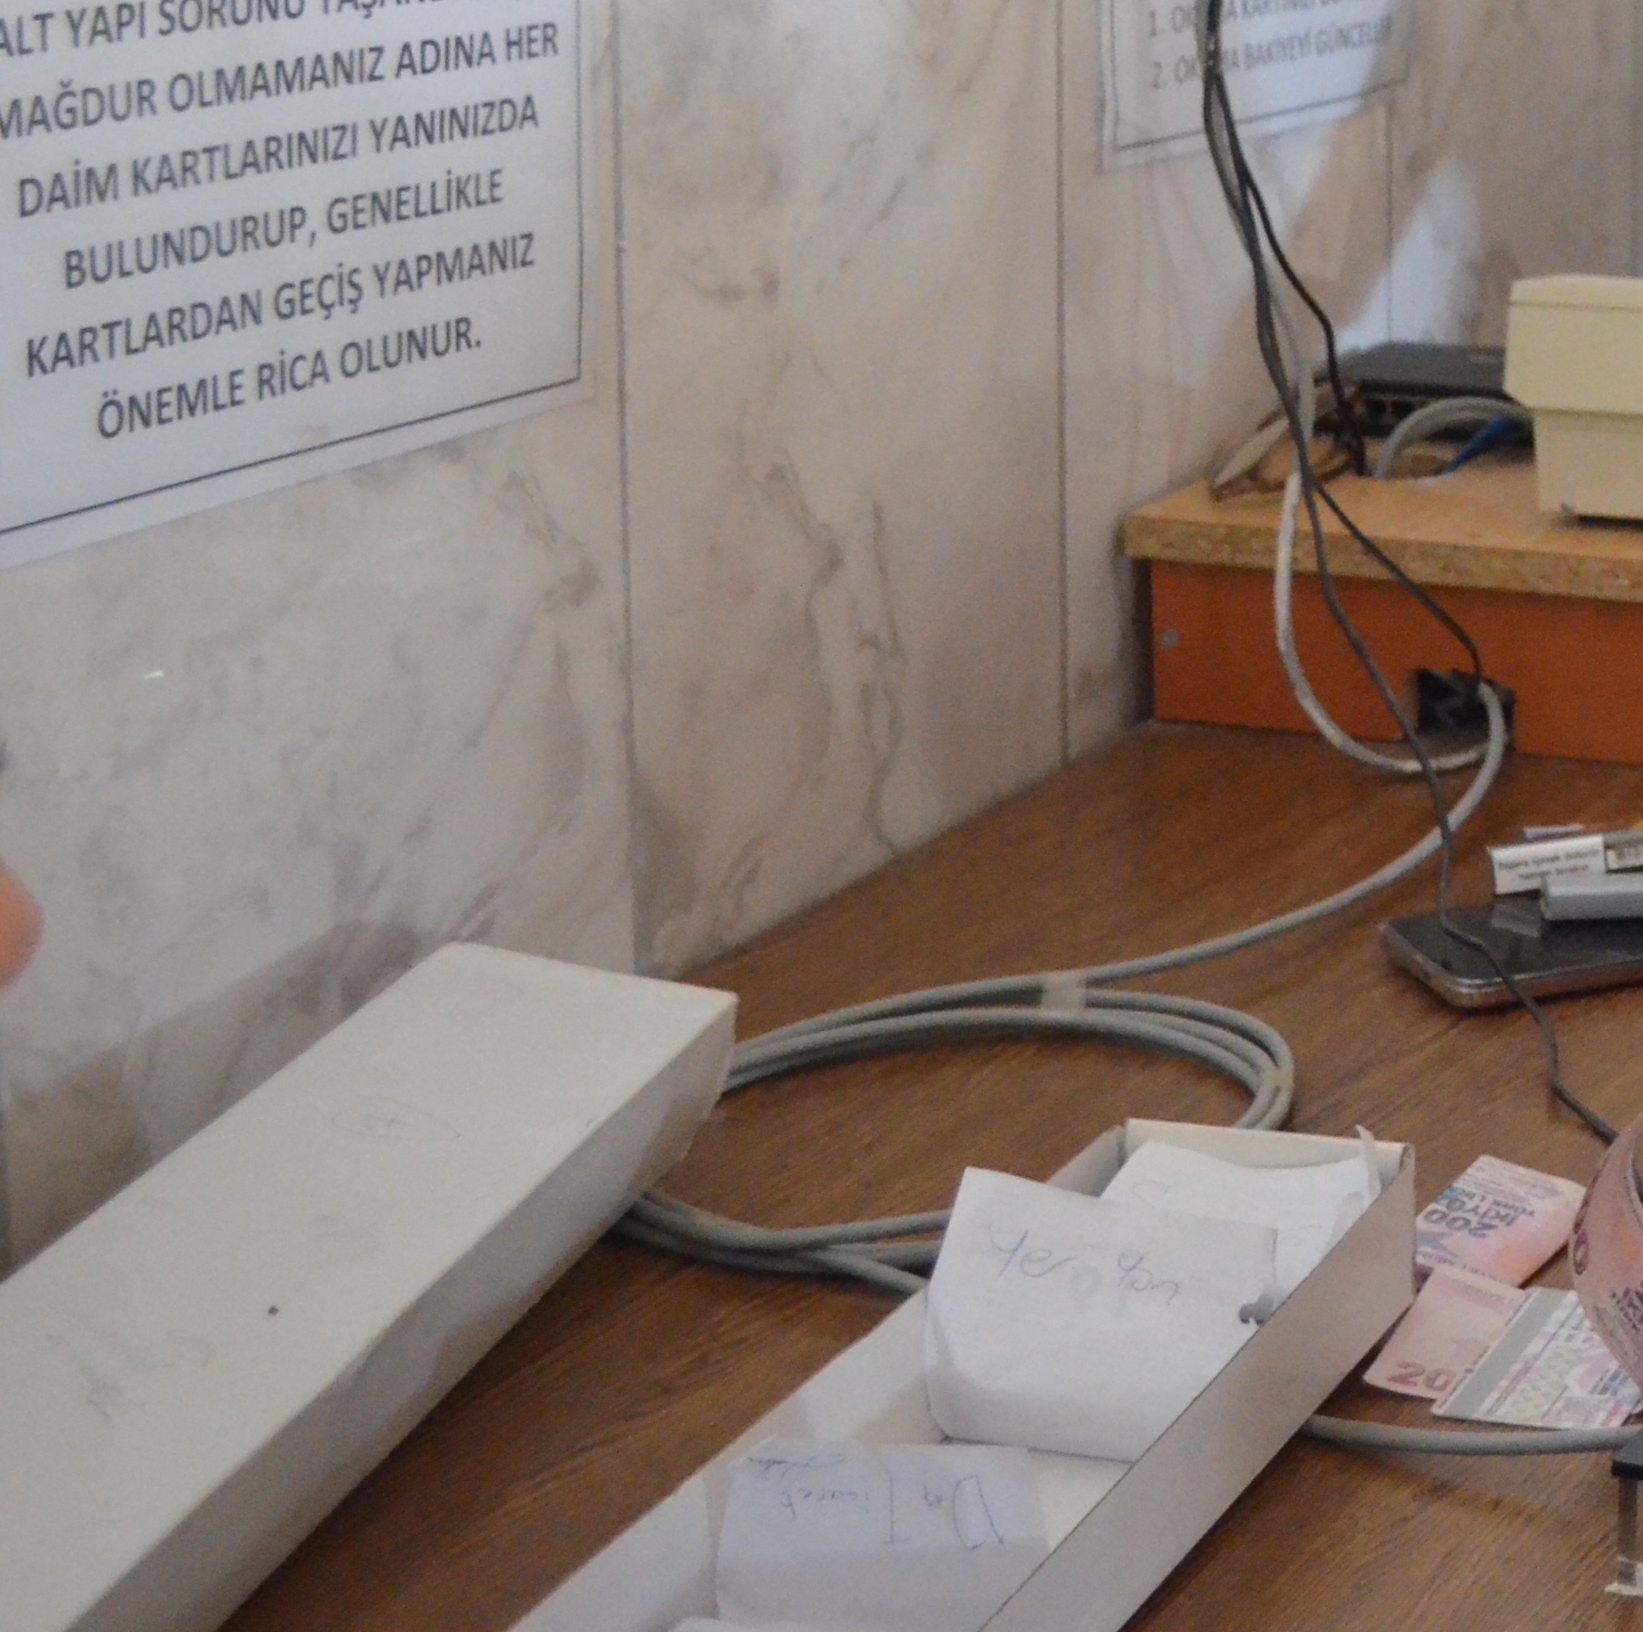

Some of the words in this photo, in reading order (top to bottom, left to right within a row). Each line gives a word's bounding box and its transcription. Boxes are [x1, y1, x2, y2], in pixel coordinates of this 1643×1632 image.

[65, 0, 147, 48] YAPI
[168, 44, 386, 113] OLMAMANIZ
[395, 30, 497, 79] ADINA
[504, 21, 560, 62] HER
[18, 157, 119, 218] DAİM
[131, 120, 359, 197] KARTLARINIZI
[369, 94, 540, 154] YANINIZDA
[64, 205, 318, 291] BULUNDURUP,
[326, 168, 504, 235] GENELLİKLE
[26, 289, 263, 378] KARTLARDAN
[273, 262, 364, 320] GEÇİŞ
[373, 230, 537, 299] YAPMANIZ
[97, 368, 246, 440] ÖNEMLE
[257, 348, 331, 401] RİCA
[339, 315, 482, 380] OLUNUR.
[1424, 1209, 1499, 1239] 200
[1395, 1361, 1458, 1392] 20
